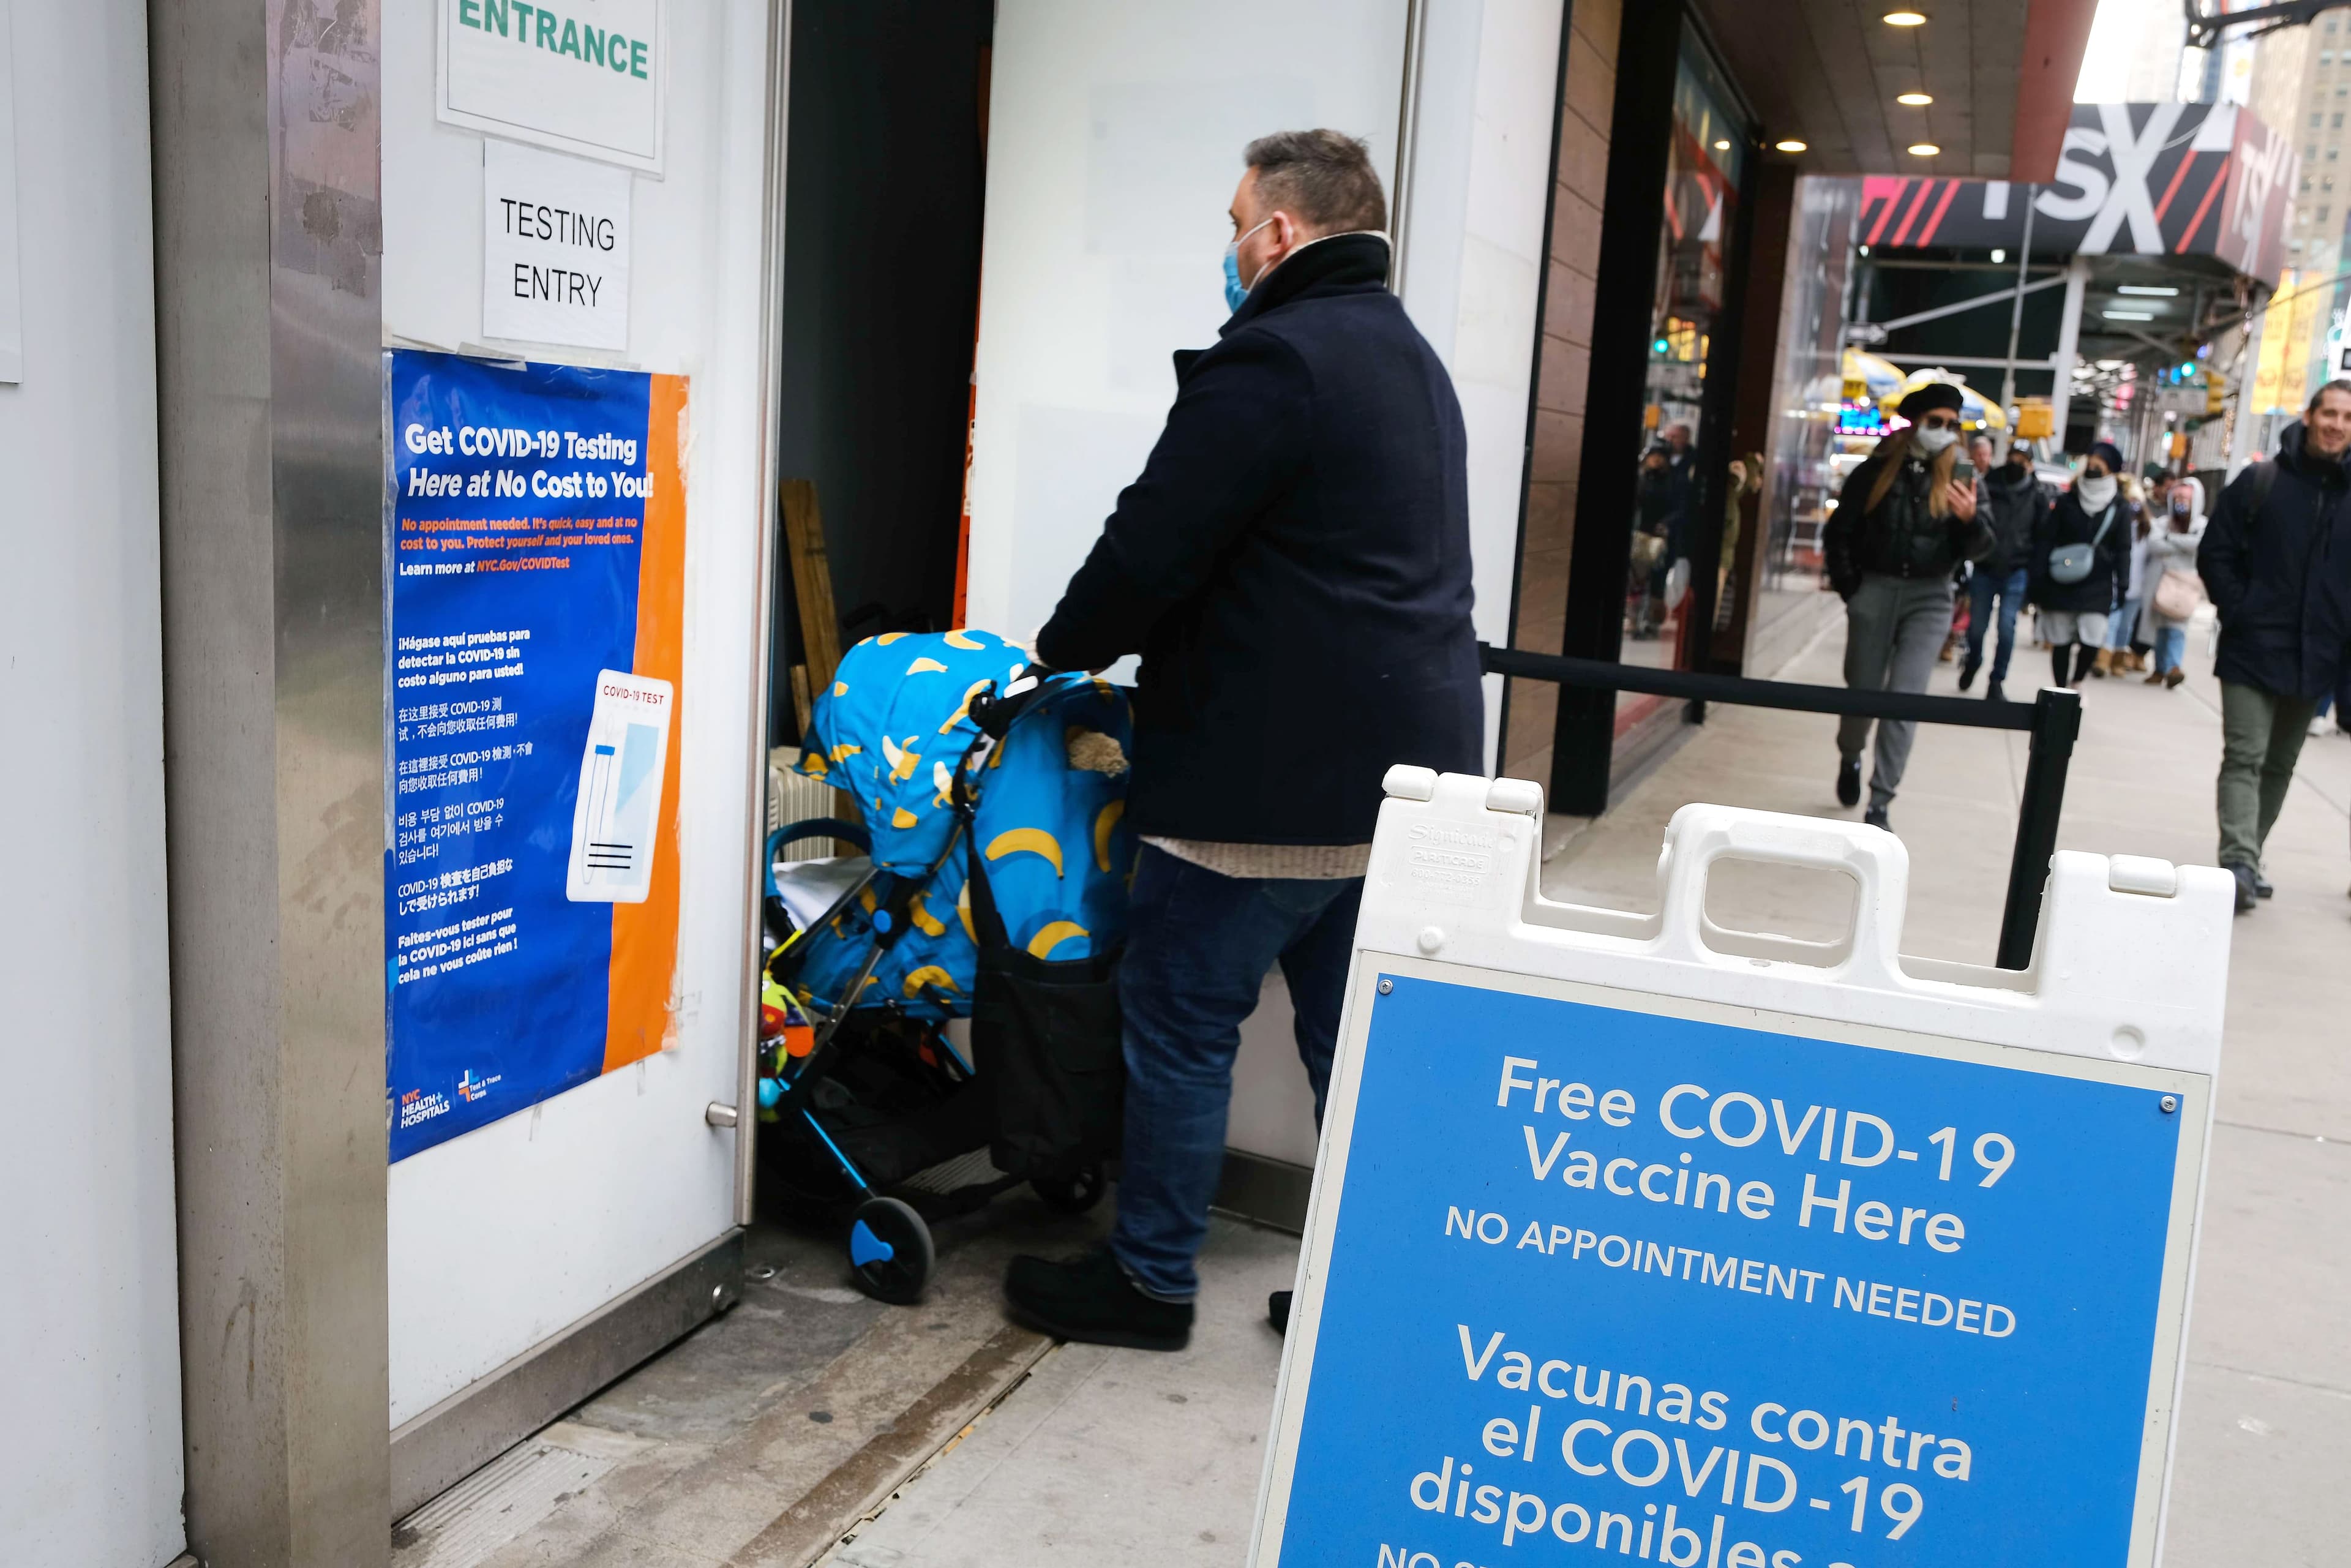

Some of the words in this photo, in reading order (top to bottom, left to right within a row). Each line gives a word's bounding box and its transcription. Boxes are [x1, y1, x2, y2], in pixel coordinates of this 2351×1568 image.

[459, 0, 647, 80] ENTRANCE
[501, 198, 614, 251] TESTING
[514, 263, 602, 307] ENTRY
[405, 423, 454, 455] Get
[459, 426, 560, 458] COVID-19
[564, 431, 637, 465] Testing
[408, 467, 462, 497] Here
[467, 470, 491, 497] at
[495, 470, 526, 498] No
[531, 471, 583, 498] Cost
[586, 471, 607, 498] to
[611, 471, 654, 498] You!
[402, 518, 417, 531] No
[419, 517, 488, 533] appointment
[490, 517, 530, 530] needed.
[549, 517, 573, 531] quick,
[575, 519, 594, 530] easy
[596, 516, 613, 528] and
[615, 517, 623, 528] at
[625, 518, 637, 527] no
[400, 537, 424, 550] cost
[426, 536, 438, 549] to
[441, 538, 465, 552] you.
[467, 536, 504, 549] Protect
[506, 534, 544, 550] yourself
[545, 533, 561, 546] and
[563, 535, 583, 547] your
[585, 533, 610, 544] loved
[612, 534, 634, 544] ones.
[400, 562, 432, 576] Learn
[435, 563, 462, 574] more
[465, 561, 475, 572] at
[476, 557, 569, 572] NYC.Gov/COVIDTest
[443, 632, 465, 648] aquí
[468, 629, 507, 647] pruebas
[509, 629, 530, 643] para
[398, 654, 443, 669] detectar
[446, 652, 456, 665] la
[458, 647, 504, 664] COVID-19
[506, 645, 520, 659] sin
[398, 673, 427, 688] costo
[429, 671, 467, 686] alguno
[469, 669, 492, 683] para
[493, 662, 523, 678] usted!
[450, 700, 490, 715] COVID-19
[604, 686, 640, 701] COVID-19
[642, 692, 664, 705] TEST
[450, 749, 491, 766] COVID-19
[399, 812, 417, 828] 비용
[421, 807, 440, 824] 부담
[444, 803, 463, 820] 없이
[467, 797, 504, 816] COVID-19
[399, 828, 427, 847] 검사를
[430, 820, 470, 839] 여기에서
[474, 816, 492, 832] 받을
[494, 813, 503, 827] 수
[399, 843, 439, 866] 있습니다!
[399, 877, 438, 898] COVID-19
[398, 923, 459, 949] Faites-vous
[462, 915, 490, 932] tester
[491, 907, 513, 925] pour
[399, 954, 408, 967] la
[410, 939, 462, 962] COVID-19
[463, 934, 474, 948] ici
[476, 929, 497, 944] sans
[498, 923, 517, 938] que
[398, 968, 421, 985] cela
[422, 965, 437, 977] ne
[440, 956, 463, 973] vous
[465, 948, 492, 965] coûte
[494, 940, 512, 956] rien
[402, 1089, 421, 1105] NYC
[469, 1082, 481, 1092] Test
[486, 1075, 501, 1084] Trace
[471, 1090, 487, 1101] Corps
[400, 1100, 450, 1129] HOSPITALS
[1498, 1056, 1635, 1127] Free
[1660, 1084, 2015, 1187] COVID-19
[1523, 1126, 1774, 1219] Vaccine
[1799, 1174, 1964, 1252] Here
[1445, 1206, 1508, 1244] NO
[1517, 1221, 1824, 1302] APPOINTMENT
[1834, 1277, 2015, 1337] NEEDED
[1458, 1324, 1729, 1430] Vacunas
[1751, 1403, 1971, 1480] contra
[1483, 1405, 1540, 1461] el
[1378, 1544, 1439, 1568] NO
